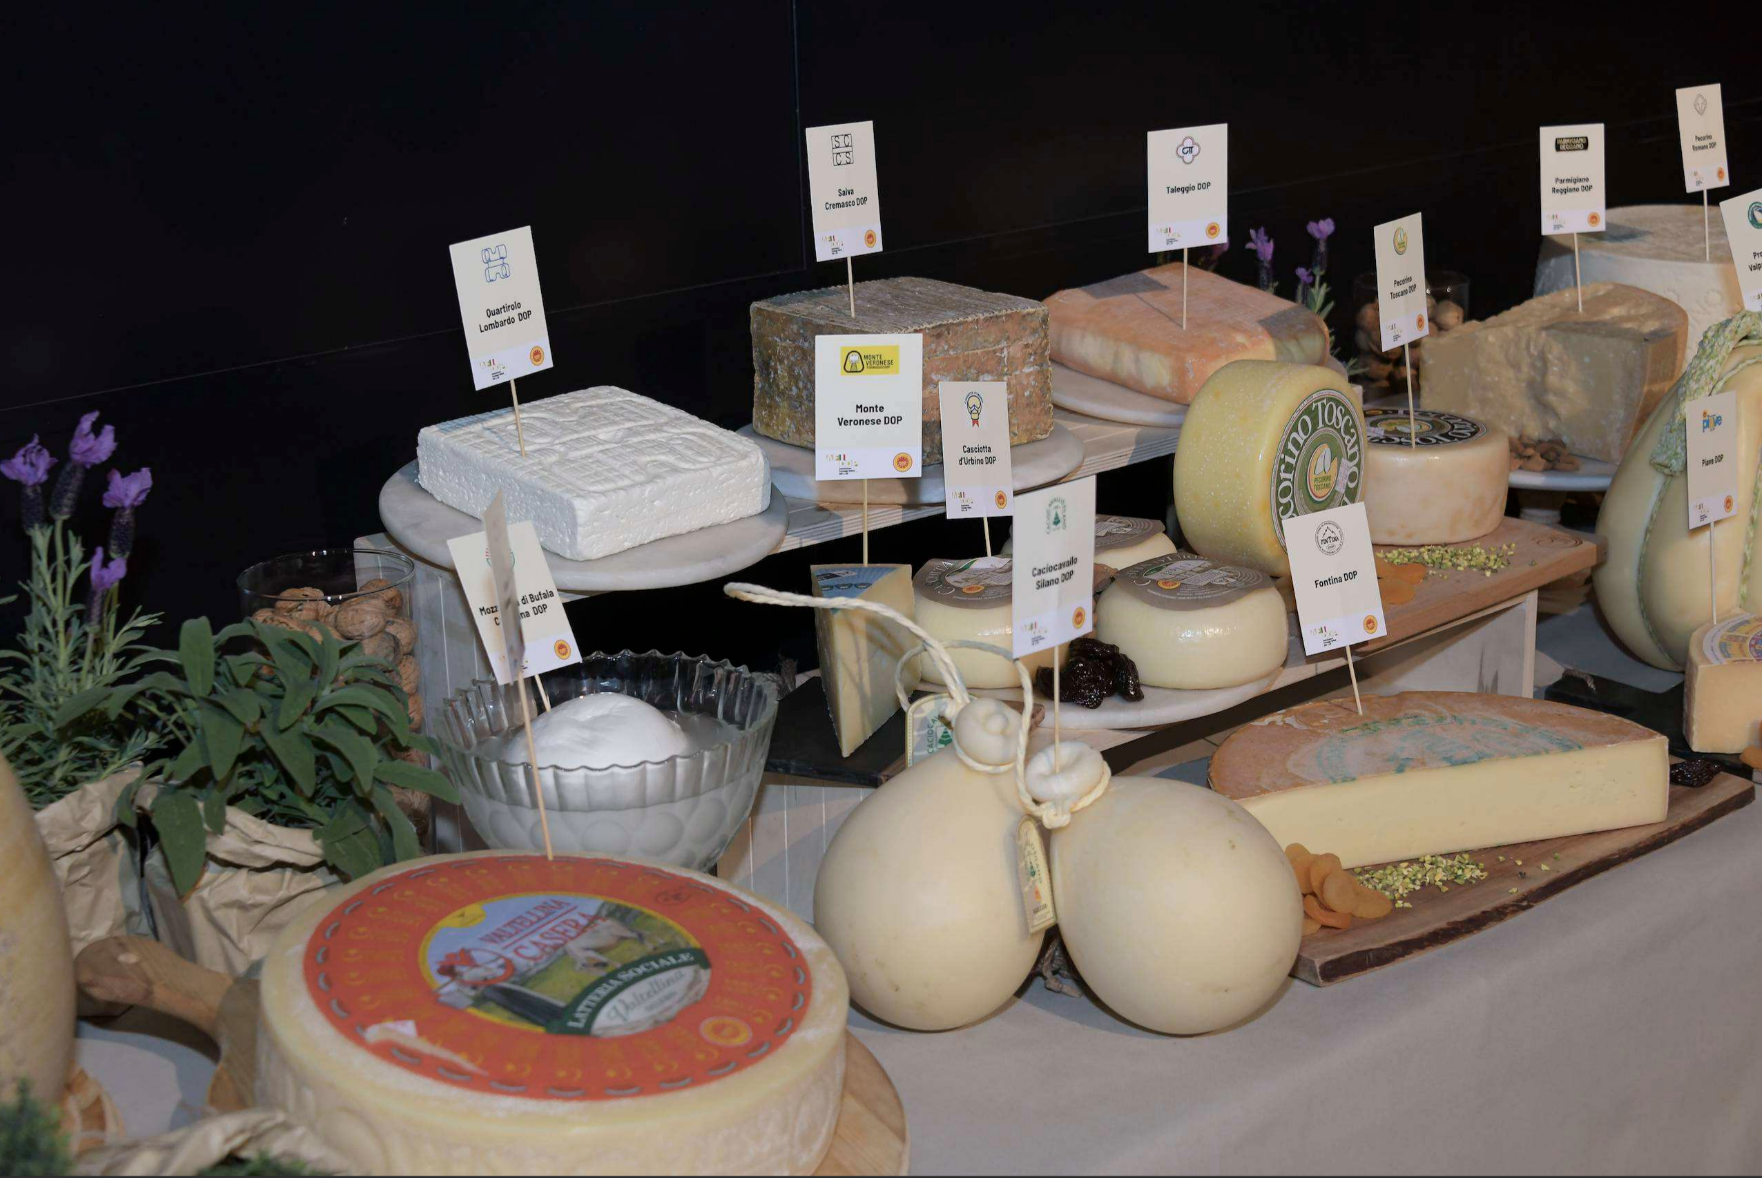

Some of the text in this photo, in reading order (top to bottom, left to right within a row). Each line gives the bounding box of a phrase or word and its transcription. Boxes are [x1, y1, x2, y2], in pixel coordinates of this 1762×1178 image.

[1694, 134, 1712, 142] Pecorino
[1692, 144, 1708, 152] Romano
[1555, 176, 1590, 184] Parmigiano
[838, 188, 854, 197] Salva
[1166, 182, 1211, 194] Taleggio DOP
[1552, 186, 1580, 195] Reggiano
[824, 196, 868, 210] Cremasco DOP
[1394, 276, 1413, 288] Pecorino
[1390, 284, 1417, 300] Toscano DOP
[486, 300, 522, 318] Quartirolo
[478, 310, 532, 333] Lombardo DOP
[856, 404, 884, 413] Monte
[837, 416, 902, 426] Veronese DOP
[962, 444, 992, 454] Casciotta
[958, 456, 996, 466] d'Urbino DOP
[1702, 454, 1724, 468] Piave DOP
[1032, 556, 1078, 578] Caciocavallo
[1036, 570, 1074, 590] Silano DOP
[1314, 570, 1358, 589] Fontina DOP
[521, 590, 554, 605] di Bufala
[532, 604, 548, 615] DOP
[479, 898, 570, 945] VALTELLINA
[513, 911, 608, 962] CASERA
[566, 976, 622, 1029] LATTERIA
[618, 952, 694, 981] SOCIALE
